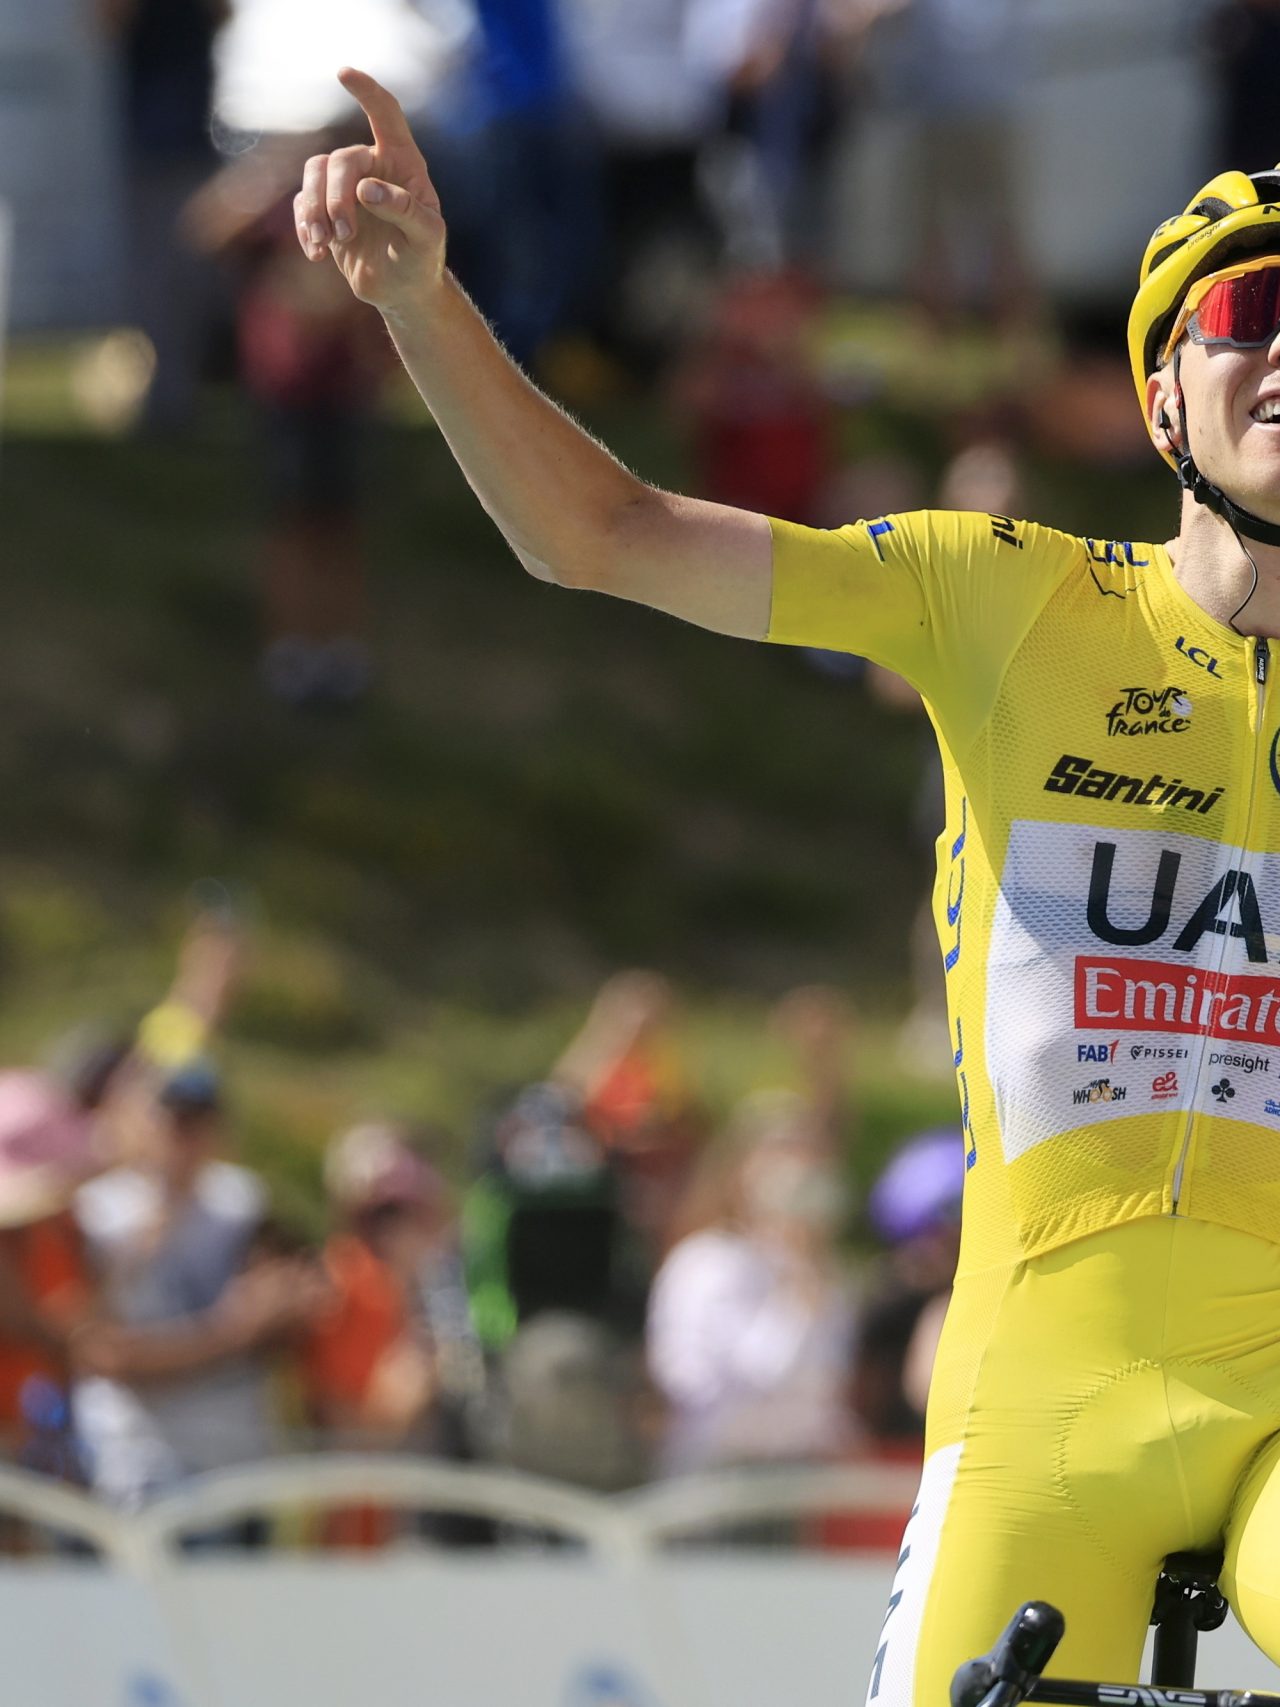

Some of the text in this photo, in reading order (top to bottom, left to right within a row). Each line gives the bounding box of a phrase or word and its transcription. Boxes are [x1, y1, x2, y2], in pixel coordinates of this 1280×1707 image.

[1175, 636, 1223, 680] LCL
[1043, 754, 1226, 815] Santini
[1144, 1048, 1189, 1059] PISSEI
[1208, 1053, 1271, 1074] presight
